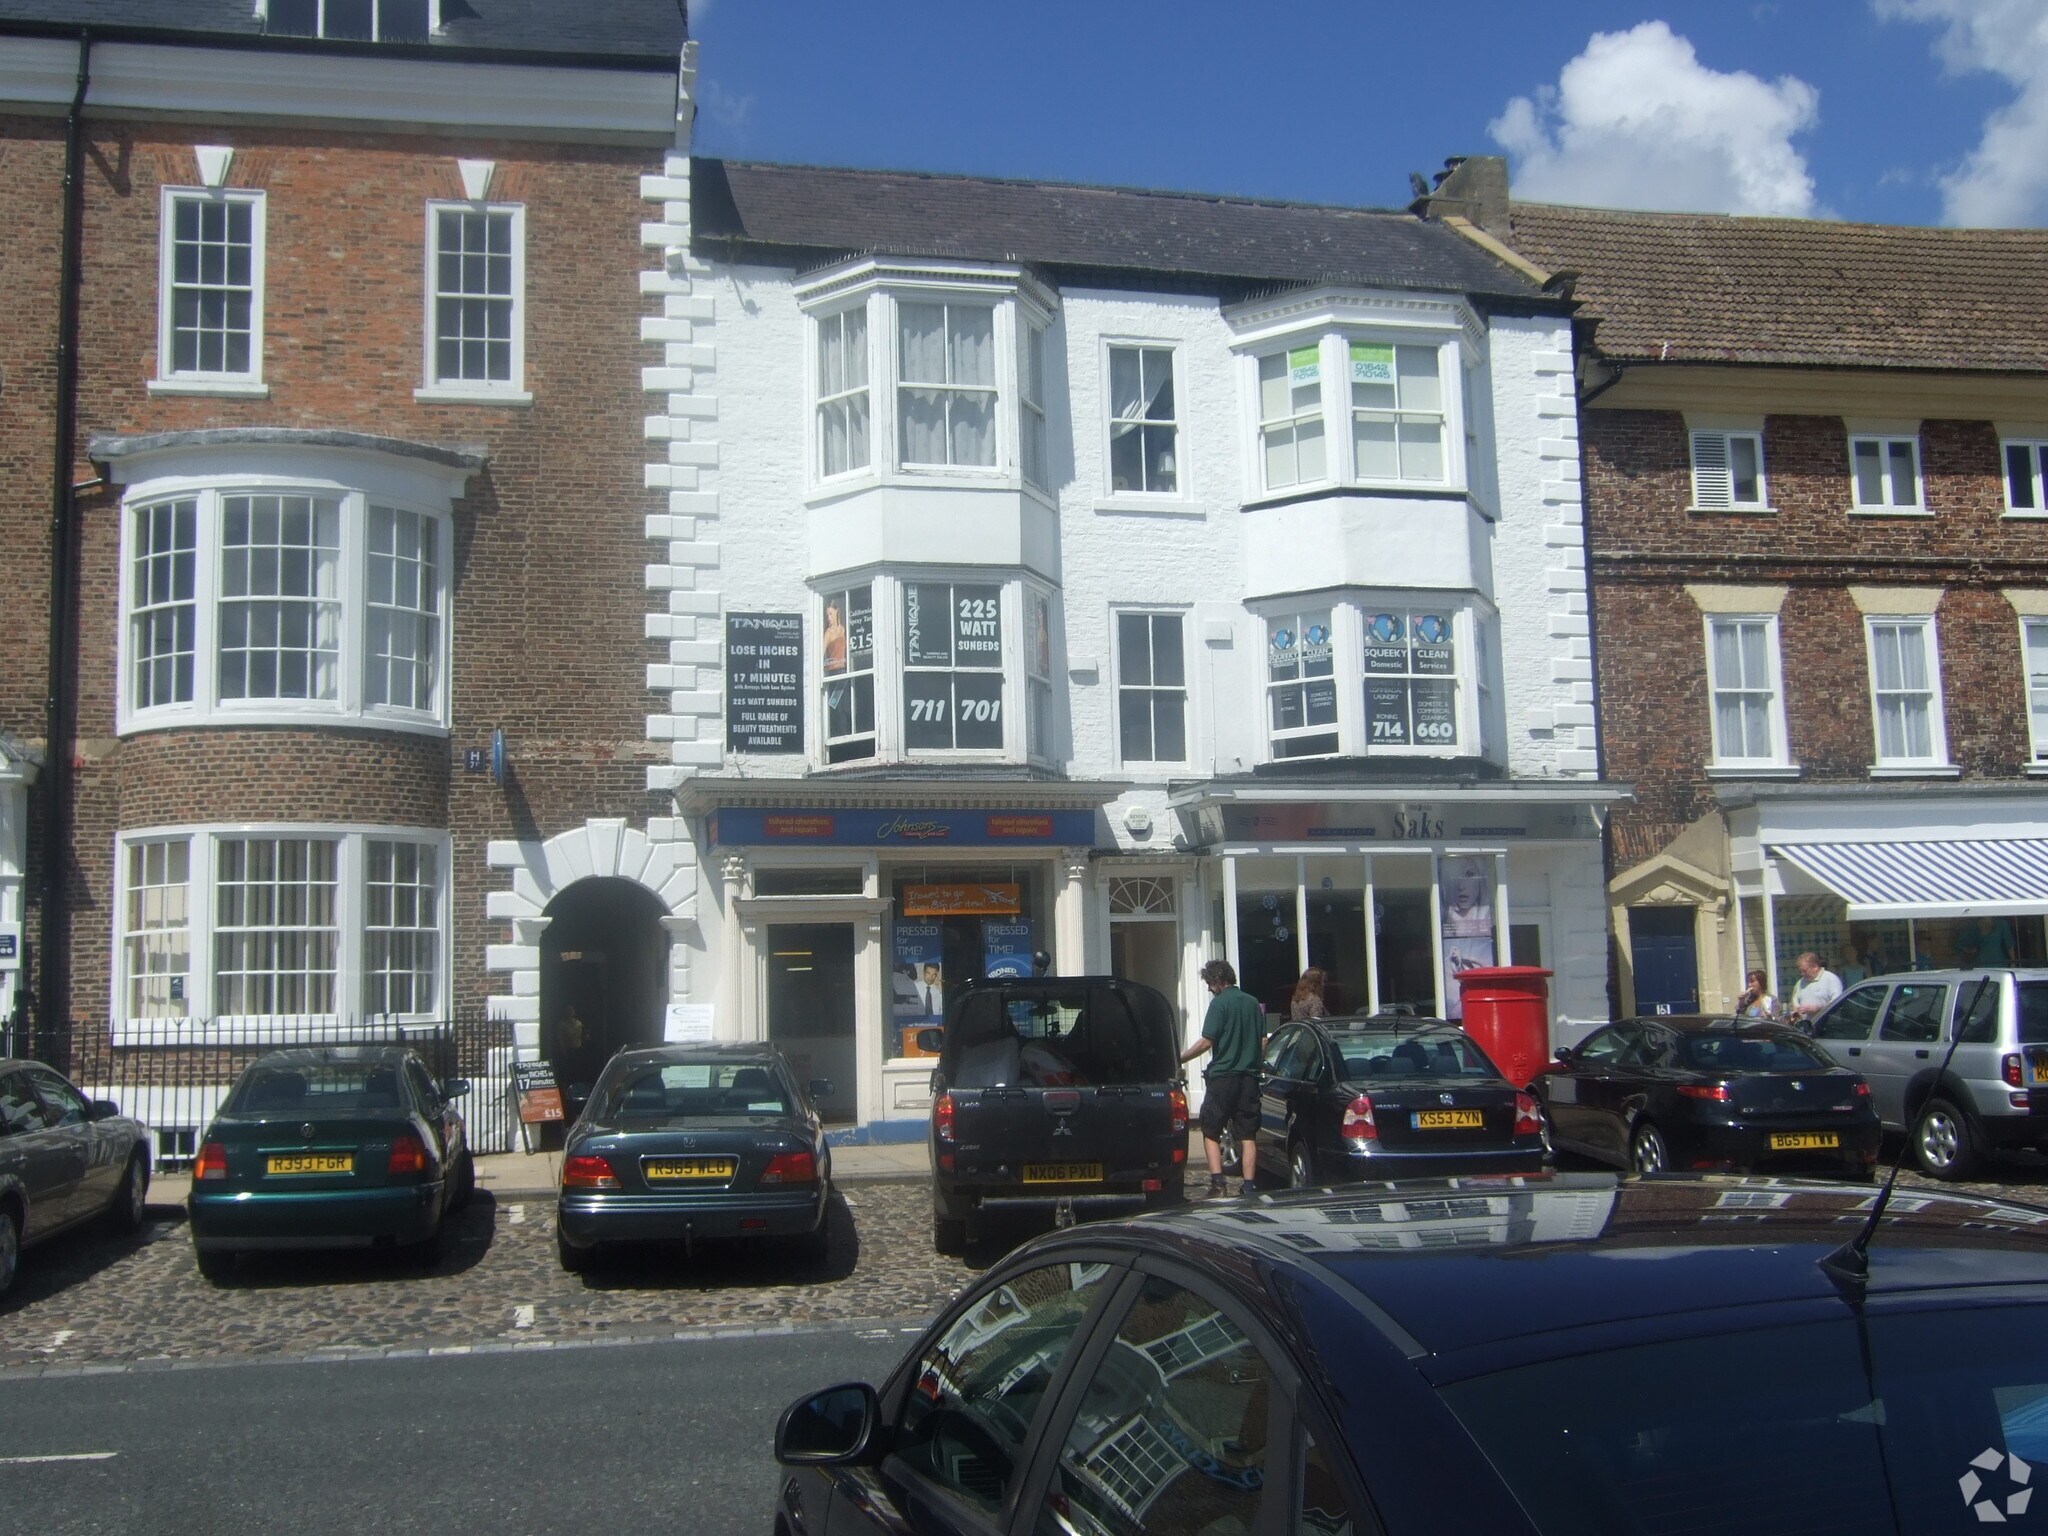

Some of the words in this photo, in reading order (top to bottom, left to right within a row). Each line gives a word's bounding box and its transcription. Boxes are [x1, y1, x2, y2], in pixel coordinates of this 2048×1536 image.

[1356, 370, 1391, 379] 710145
[960, 599, 997, 618] 225
[730, 618, 800, 630] TANIQUE
[908, 584, 921, 663] TANIQUE
[960, 621, 997, 636] WATT
[849, 633, 873, 650] £15
[958, 641, 1000, 651] SUNBEDS
[731, 645, 756, 655] LOSE
[760, 646, 798, 656] INCHES
[1365, 649, 1407, 658] SQUEEKY
[1417, 650, 1448, 659] CLEAN
[759, 659, 770, 670] IN
[1371, 661, 1403, 669] Domestic
[734, 674, 746, 683] 17
[750, 674, 797, 684] MINUTES
[733, 698, 746, 706] 225
[748, 698, 765, 706] WATT
[911, 700, 946, 721] 711
[961, 700, 1000, 721] 701
[742, 713, 756, 721] FULL
[758, 713, 779, 721] RANGE
[780, 714, 788, 722] OF
[733, 725, 757, 733] BEAUTY
[758, 725, 797, 734] TREATMENTS
[1373, 722, 1404, 737] 714
[1417, 722, 1453, 737] 660
[748, 737, 782, 746] AVAILABLE
[471, 752, 480, 761] H
[877, 815, 950, 839] Johnsons
[1392, 811, 1444, 840] Saks
[897, 926, 939, 936] PRESSED
[988, 925, 1029, 935] PRESSED
[897, 937, 907, 945] for
[989, 936, 999, 944] for
[897, 946, 923, 956] TIME?
[988, 945, 1015, 955] TIME?
[518, 1079, 530, 1090] 17
[545, 1109, 562, 1118] £15
[1420, 1112, 1454, 1125] KS53
[1457, 1111, 1480, 1124] ZYN
[1777, 1135, 1808, 1148] BG57
[274, 1158, 312, 1171] R393
[317, 1157, 346, 1170] FGR
[655, 1160, 693, 1175] R965
[699, 1159, 725, 1174] WLO
[1029, 1165, 1066, 1180] NX06
[1070, 1164, 1097, 1179] PXU
